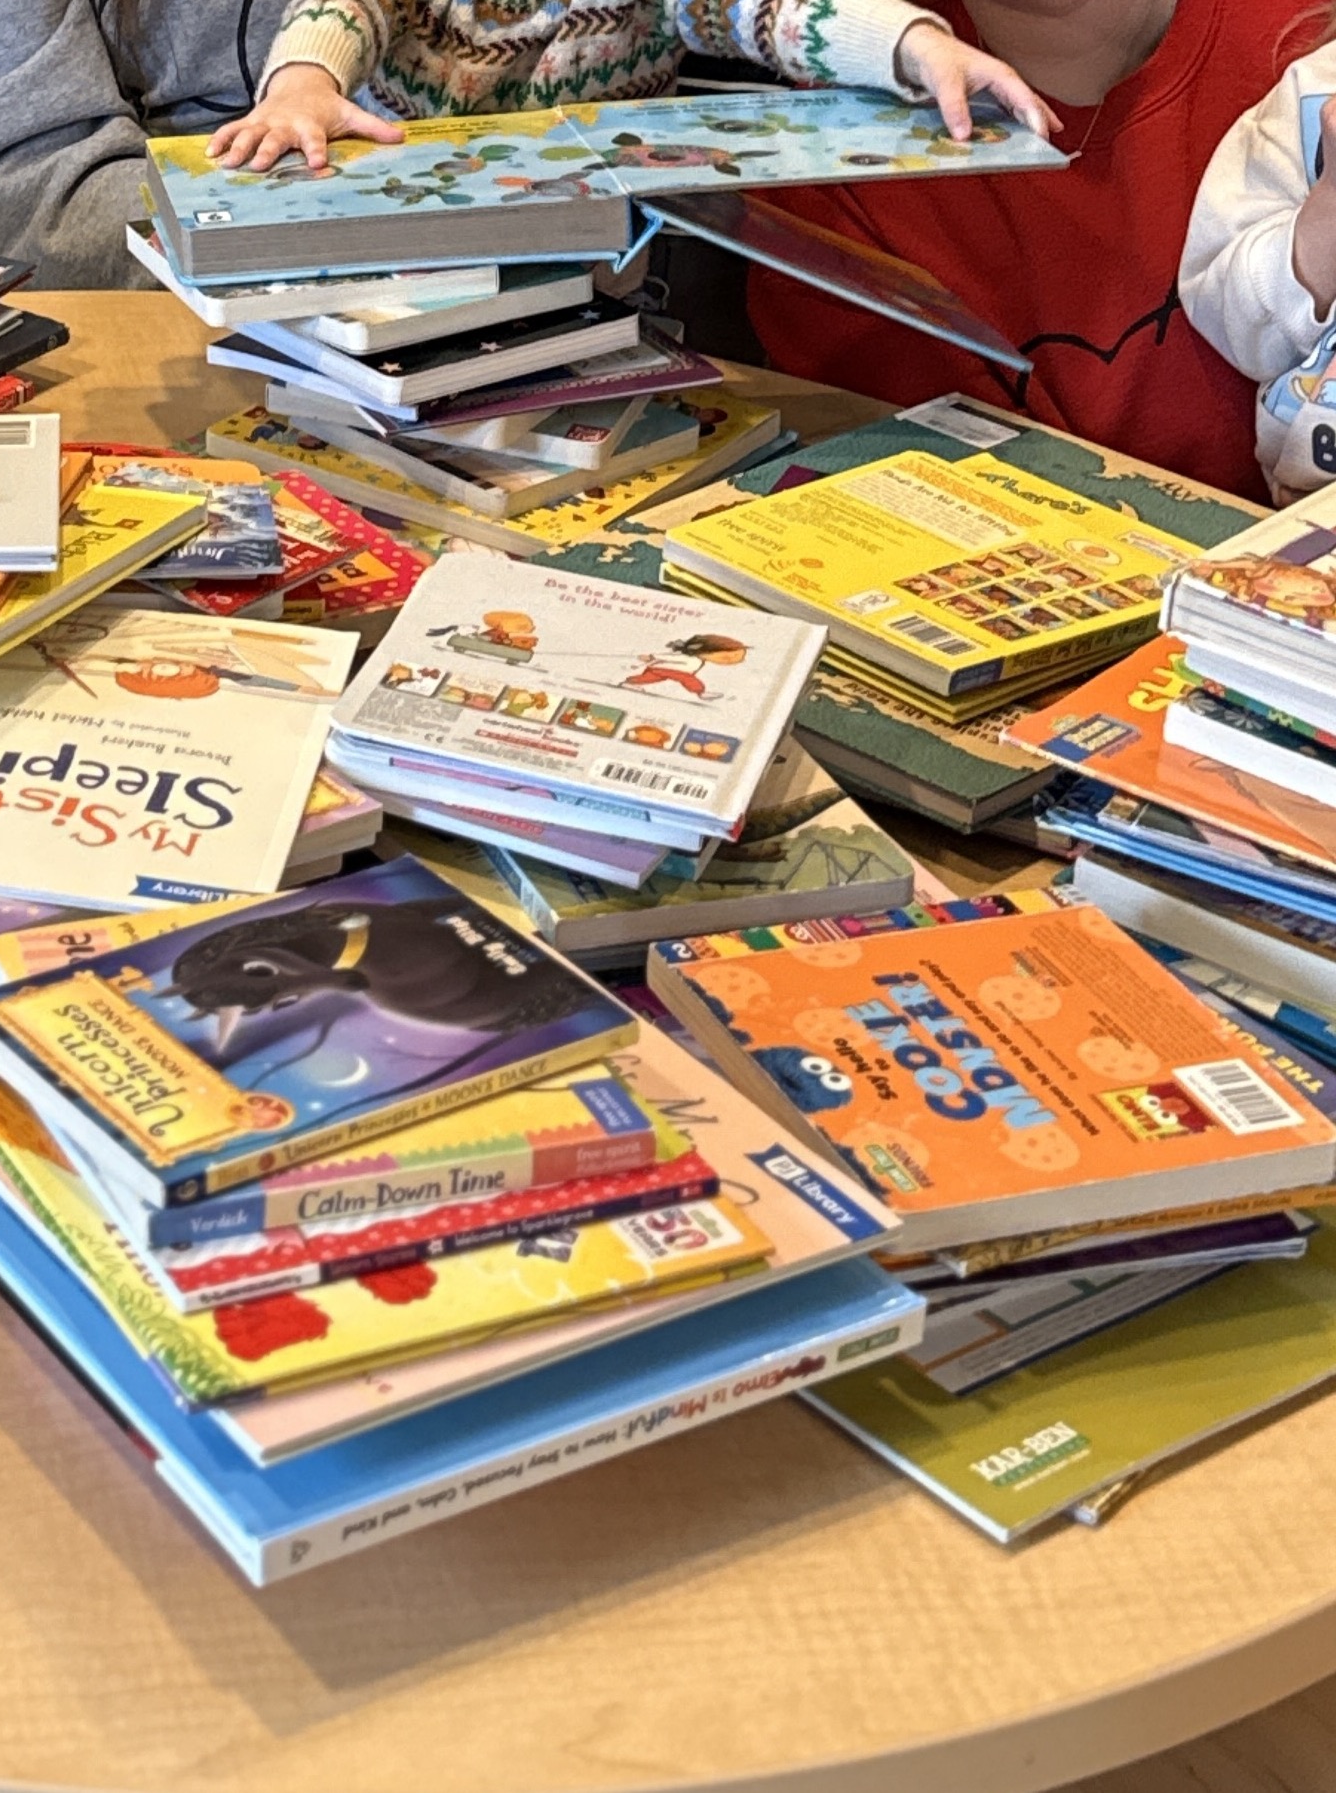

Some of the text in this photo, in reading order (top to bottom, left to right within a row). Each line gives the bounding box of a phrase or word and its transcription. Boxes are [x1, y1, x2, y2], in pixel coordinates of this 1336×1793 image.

[574, 585, 604, 598] the
[583, 597, 613, 611] the
[128, 818, 203, 858] My
[52, 1002, 189, 1105] Princesses
[90, 997, 192, 1080] MOON'S DANCE
[842, 997, 989, 1122] COOKIE
[871, 971, 1059, 1130] MONSTER!
[55, 1032, 185, 1138] Unicorn
[282, 1058, 549, 1163] Unicorn Princesses MOON'S DANCE
[575, 1139, 642, 1162] free spirit
[296, 1174, 443, 1221] Calm-Down
[447, 1166, 506, 1200] Time
[793, 1169, 859, 1227] Library
[528, 1447, 560, 1470] Stay
[581, 1427, 618, 1449] How
[969, 1419, 1082, 1480] KAR-BEN
[341, 1516, 377, 1542] Kind
[385, 1501, 412, 1521] and
